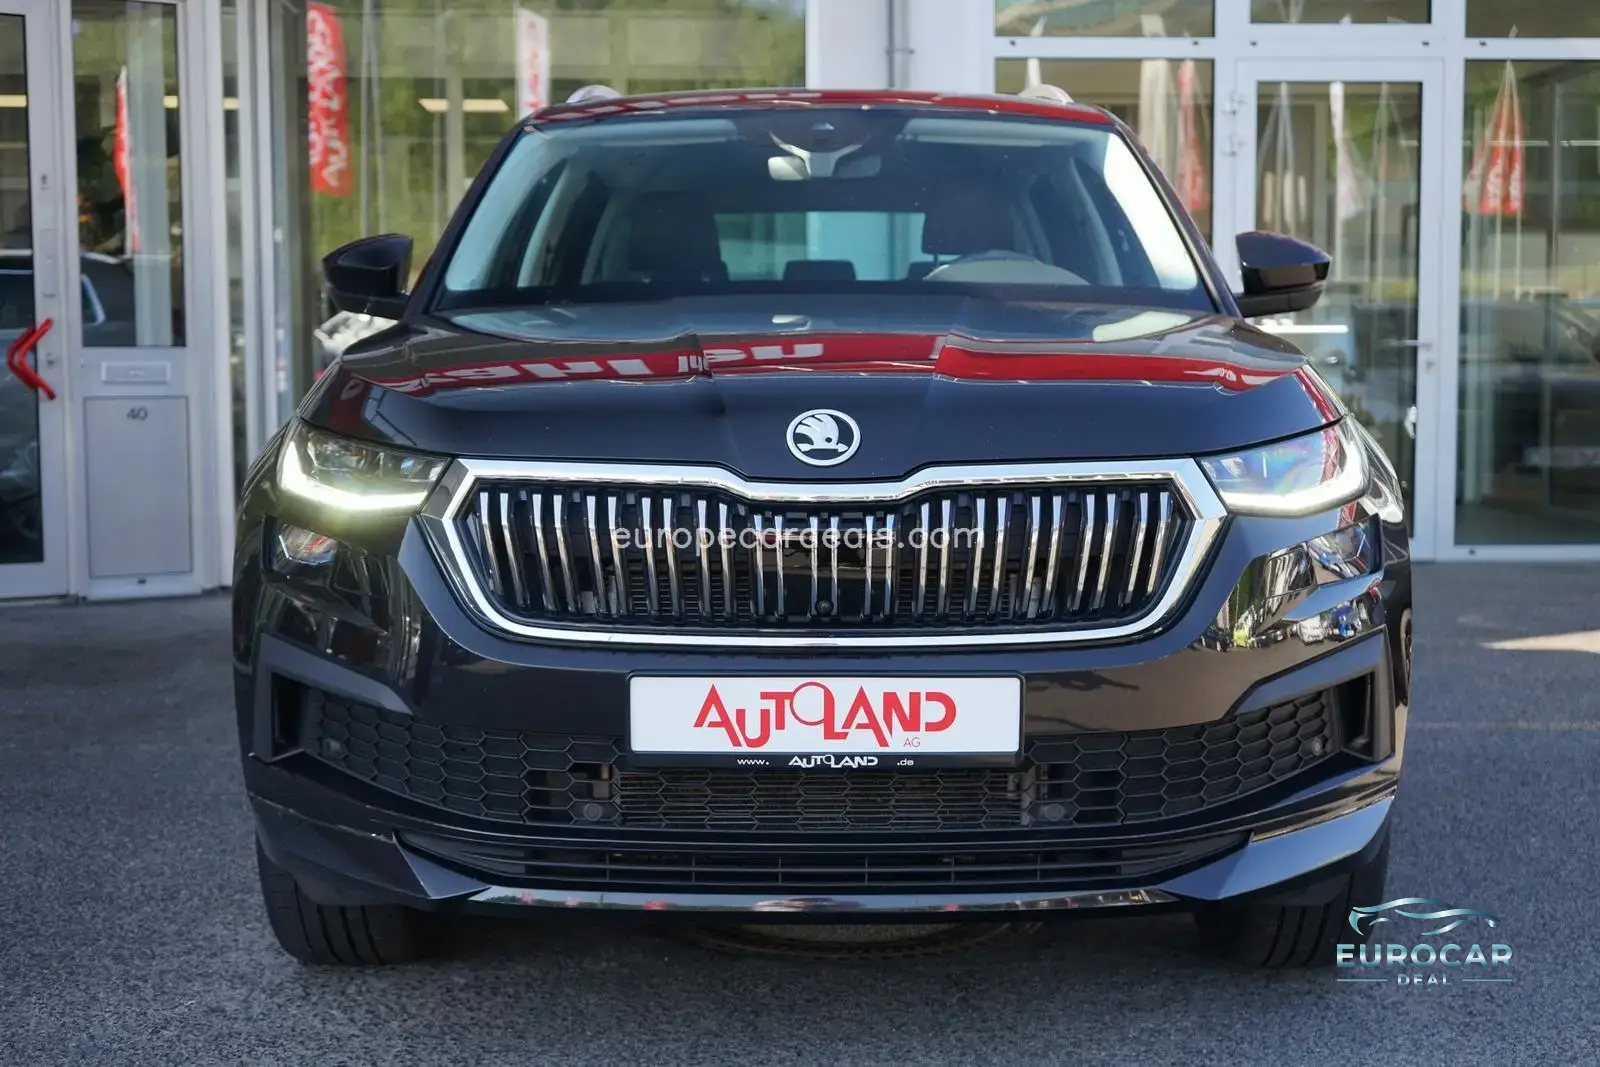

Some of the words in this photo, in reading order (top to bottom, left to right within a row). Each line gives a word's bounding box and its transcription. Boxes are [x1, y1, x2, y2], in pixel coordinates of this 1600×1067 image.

[126, 405, 149, 422] 40
[693, 681, 957, 748] AUTOLAND
[903, 736, 921, 748] AG
